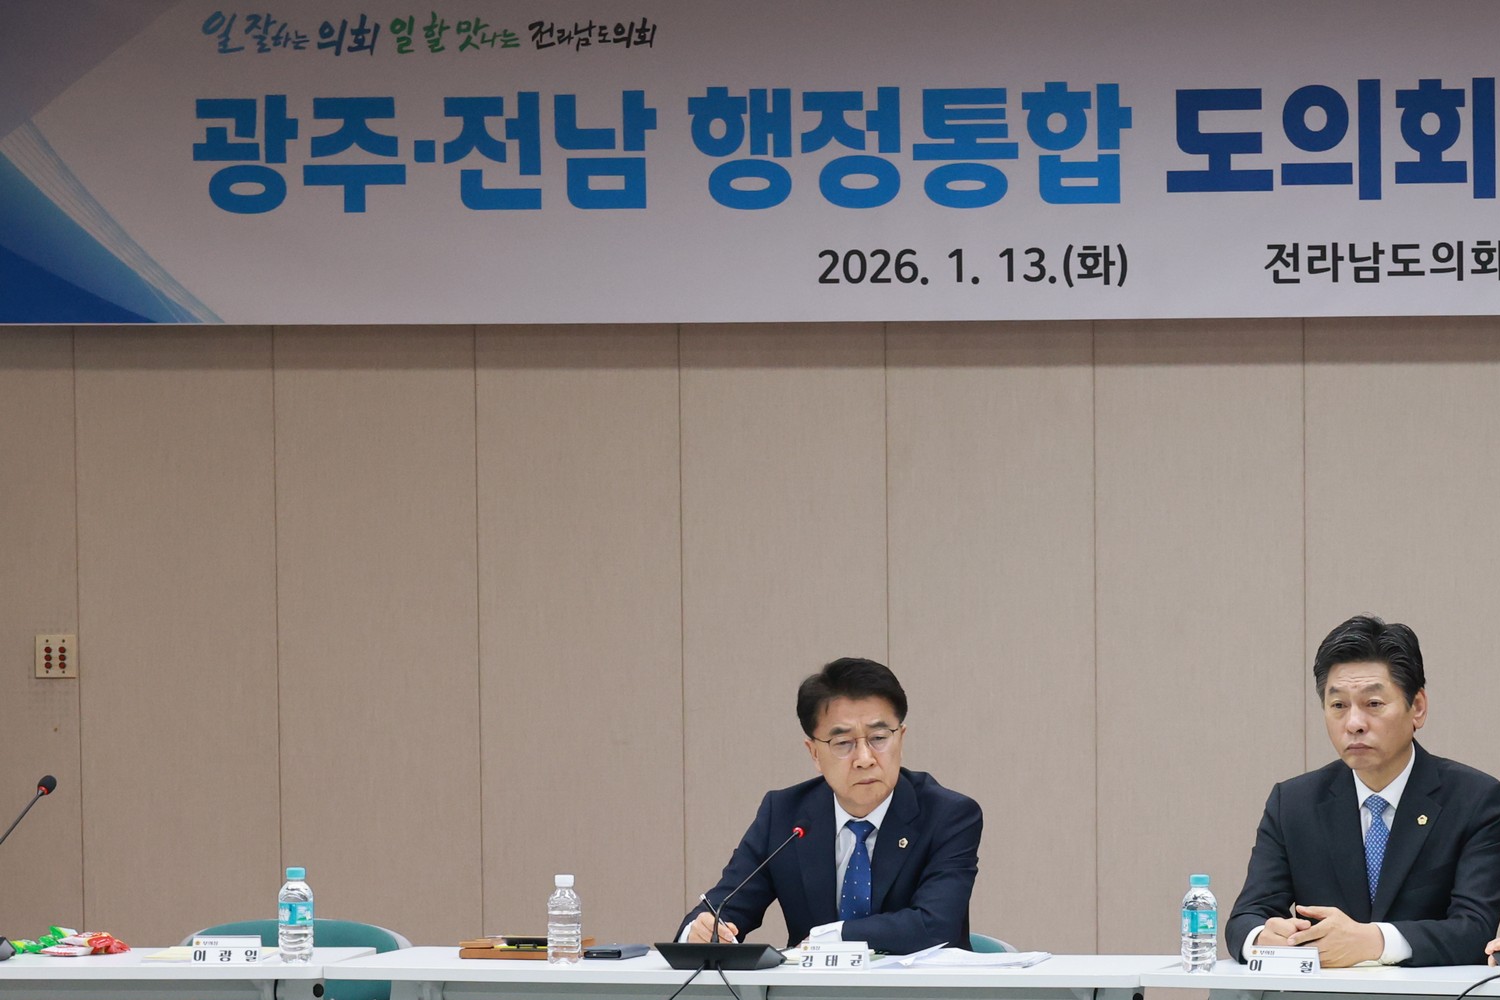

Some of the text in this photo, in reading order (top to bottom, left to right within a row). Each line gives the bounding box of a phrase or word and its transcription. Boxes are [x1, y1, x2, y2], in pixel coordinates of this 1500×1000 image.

[244, 13, 310, 53] 잘하는
[317, 13, 381, 57] 의회
[528, 17, 658, 52] 전라남도의회
[687, 81, 1133, 211] 행정통합
[817, 244, 1129, 289] 2026. 1. 13.(화)
